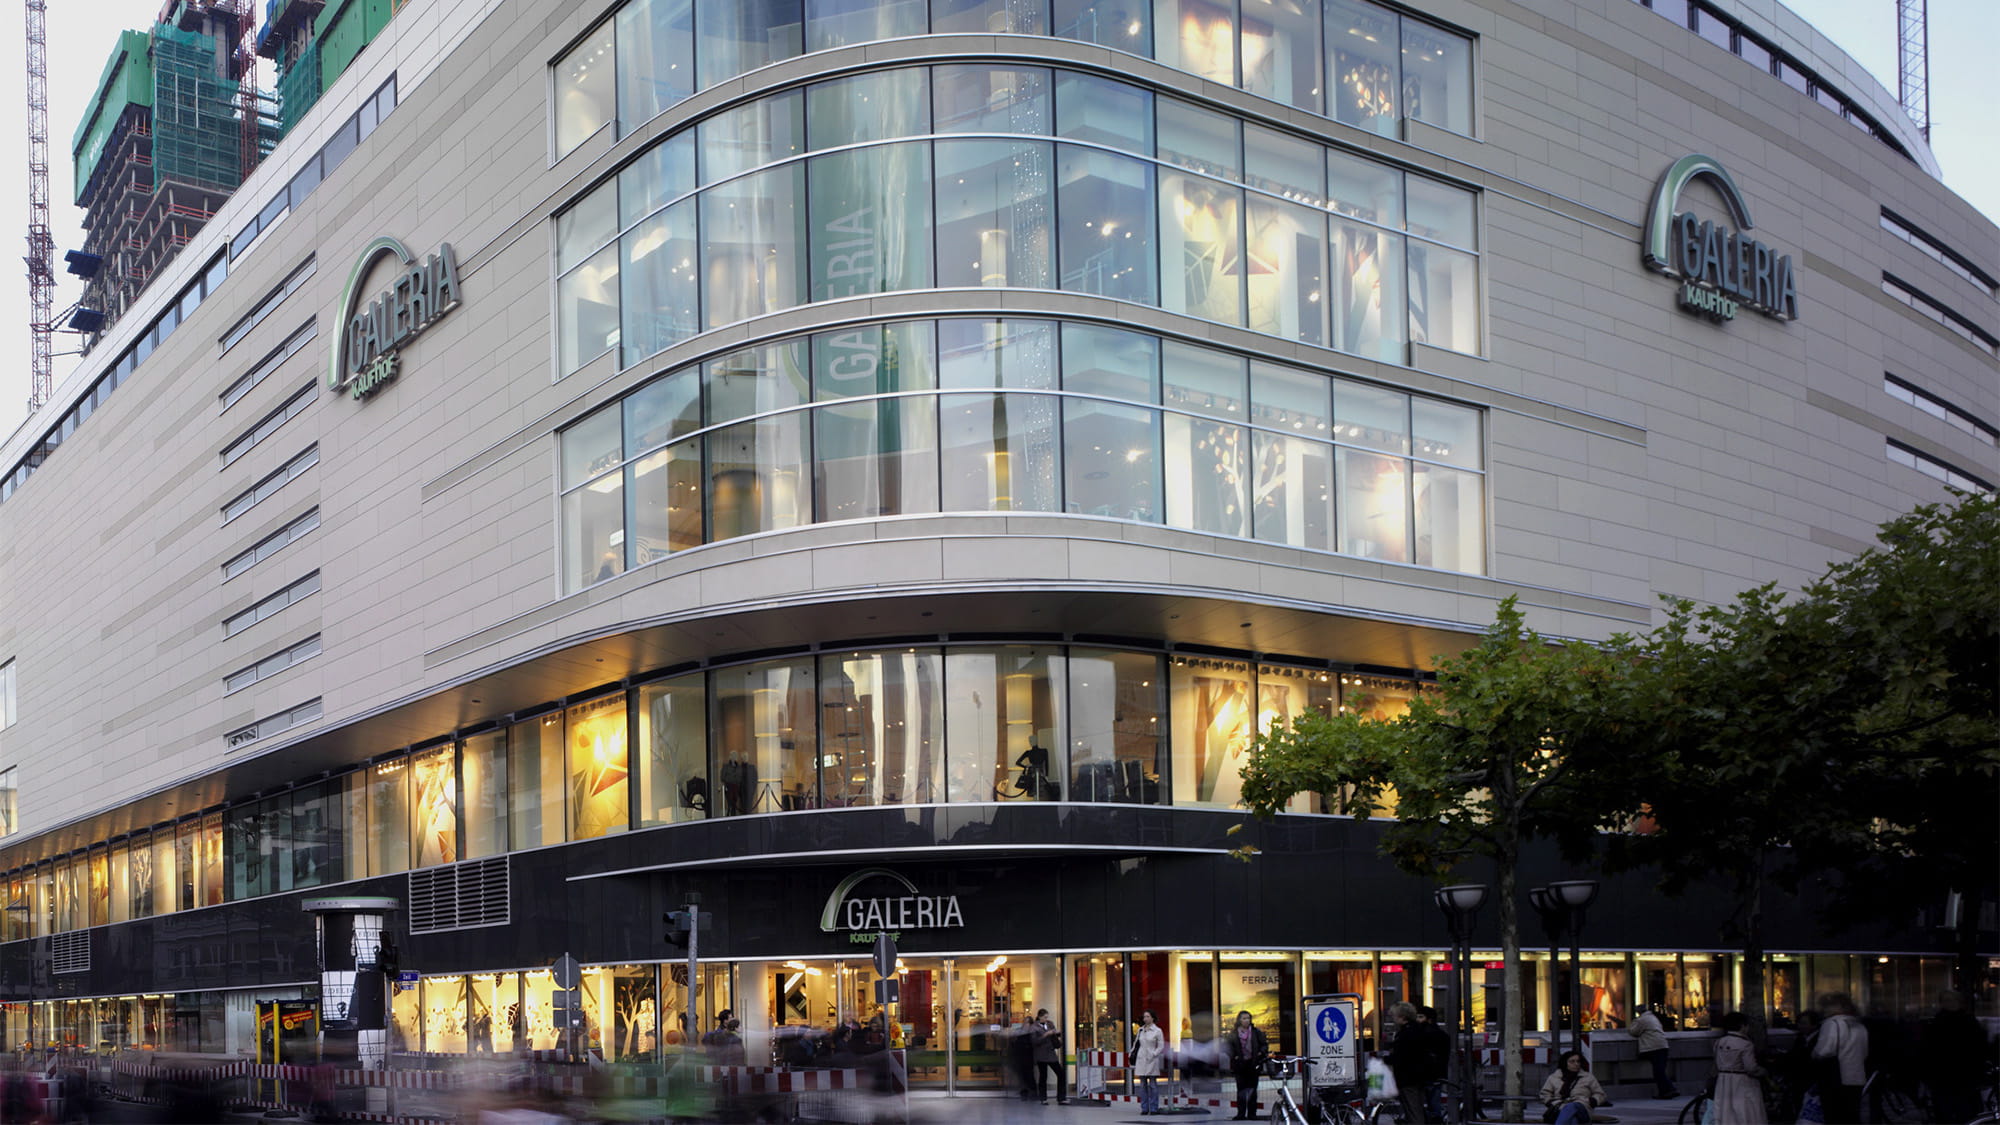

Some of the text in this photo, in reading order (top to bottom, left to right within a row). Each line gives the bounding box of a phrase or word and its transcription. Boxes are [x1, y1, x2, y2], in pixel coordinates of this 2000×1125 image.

[1678, 212, 1799, 320] GALERIA
[349, 242, 459, 373] GALERIA
[848, 896, 964, 930] GALERIA
[1320, 1045, 1344, 1055] ZONE
